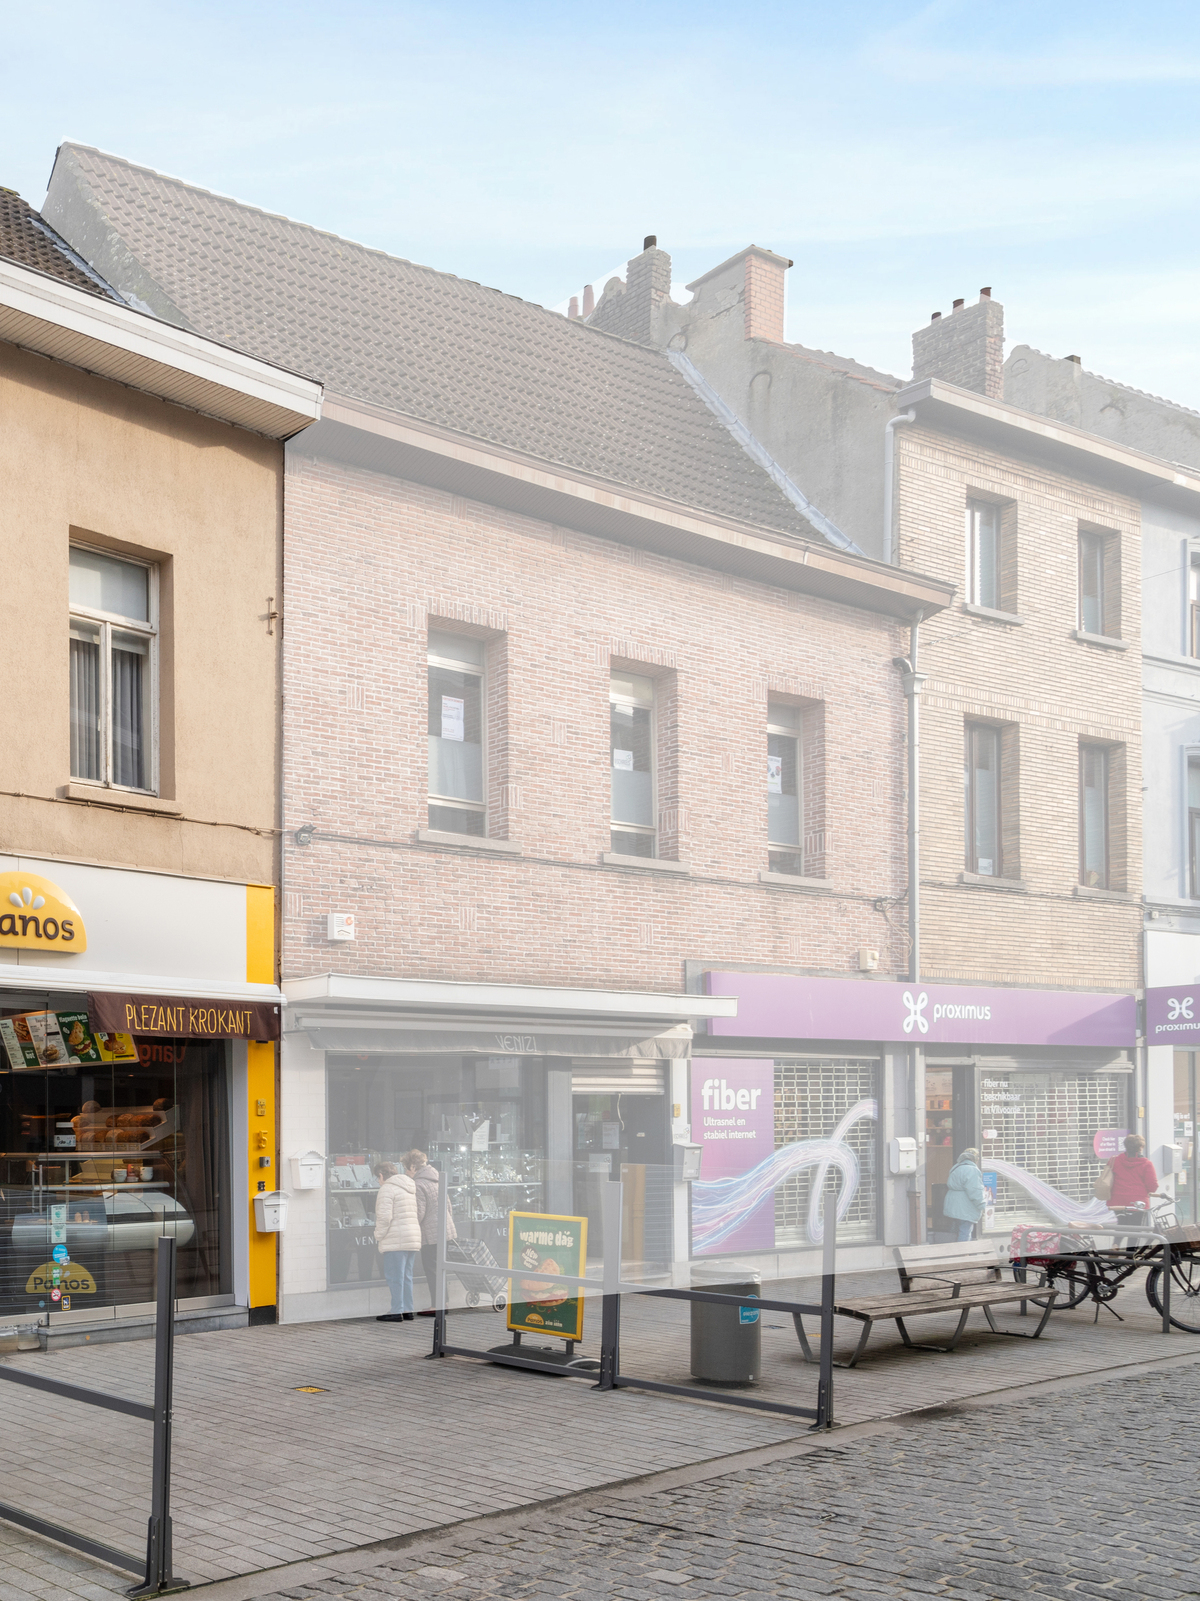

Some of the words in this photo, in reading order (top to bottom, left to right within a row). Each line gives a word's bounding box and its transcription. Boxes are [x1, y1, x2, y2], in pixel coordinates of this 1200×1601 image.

[125, 1004, 186, 1032] PLEZANT
[189, 1008, 252, 1035] KROKANT
[933, 1003, 992, 1023] proximus
[494, 1035, 537, 1052] VENIZI
[701, 1078, 762, 1110] fiber
[703, 1116, 736, 1126] Ultrasnel
[258, 1130, 268, 1149] 5
[703, 1130, 727, 1139] stabiel
[728, 1130, 756, 1139] internet
[520, 1231, 554, 1246] warme
[555, 1232, 574, 1247] dag
[33, 1276, 90, 1290] Panos
